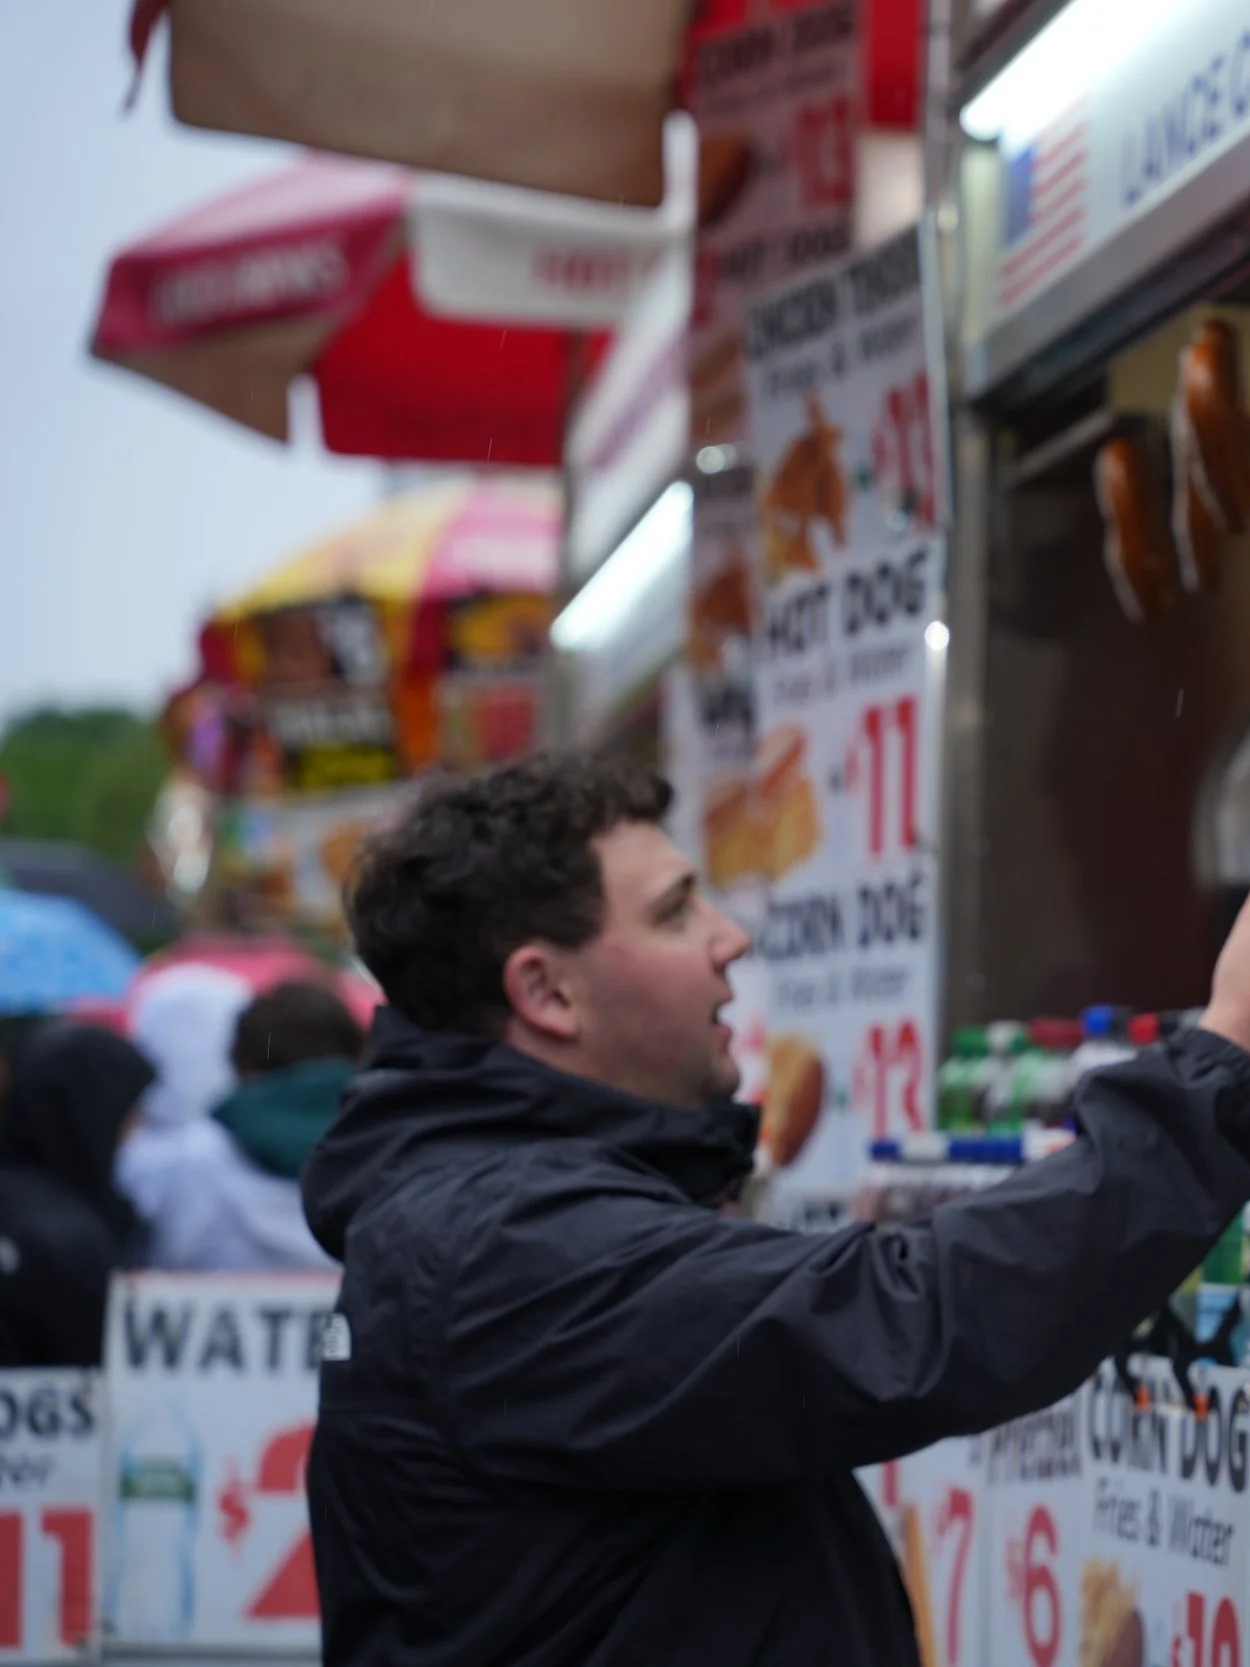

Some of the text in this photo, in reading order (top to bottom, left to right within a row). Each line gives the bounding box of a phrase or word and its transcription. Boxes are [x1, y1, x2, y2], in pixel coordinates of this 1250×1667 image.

[767, 545, 929, 657] HOT DOG
[857, 870, 924, 950] DOG
[1178, 1385, 1249, 1494] DOG
[1093, 1476, 1236, 1569] Fries & Water
